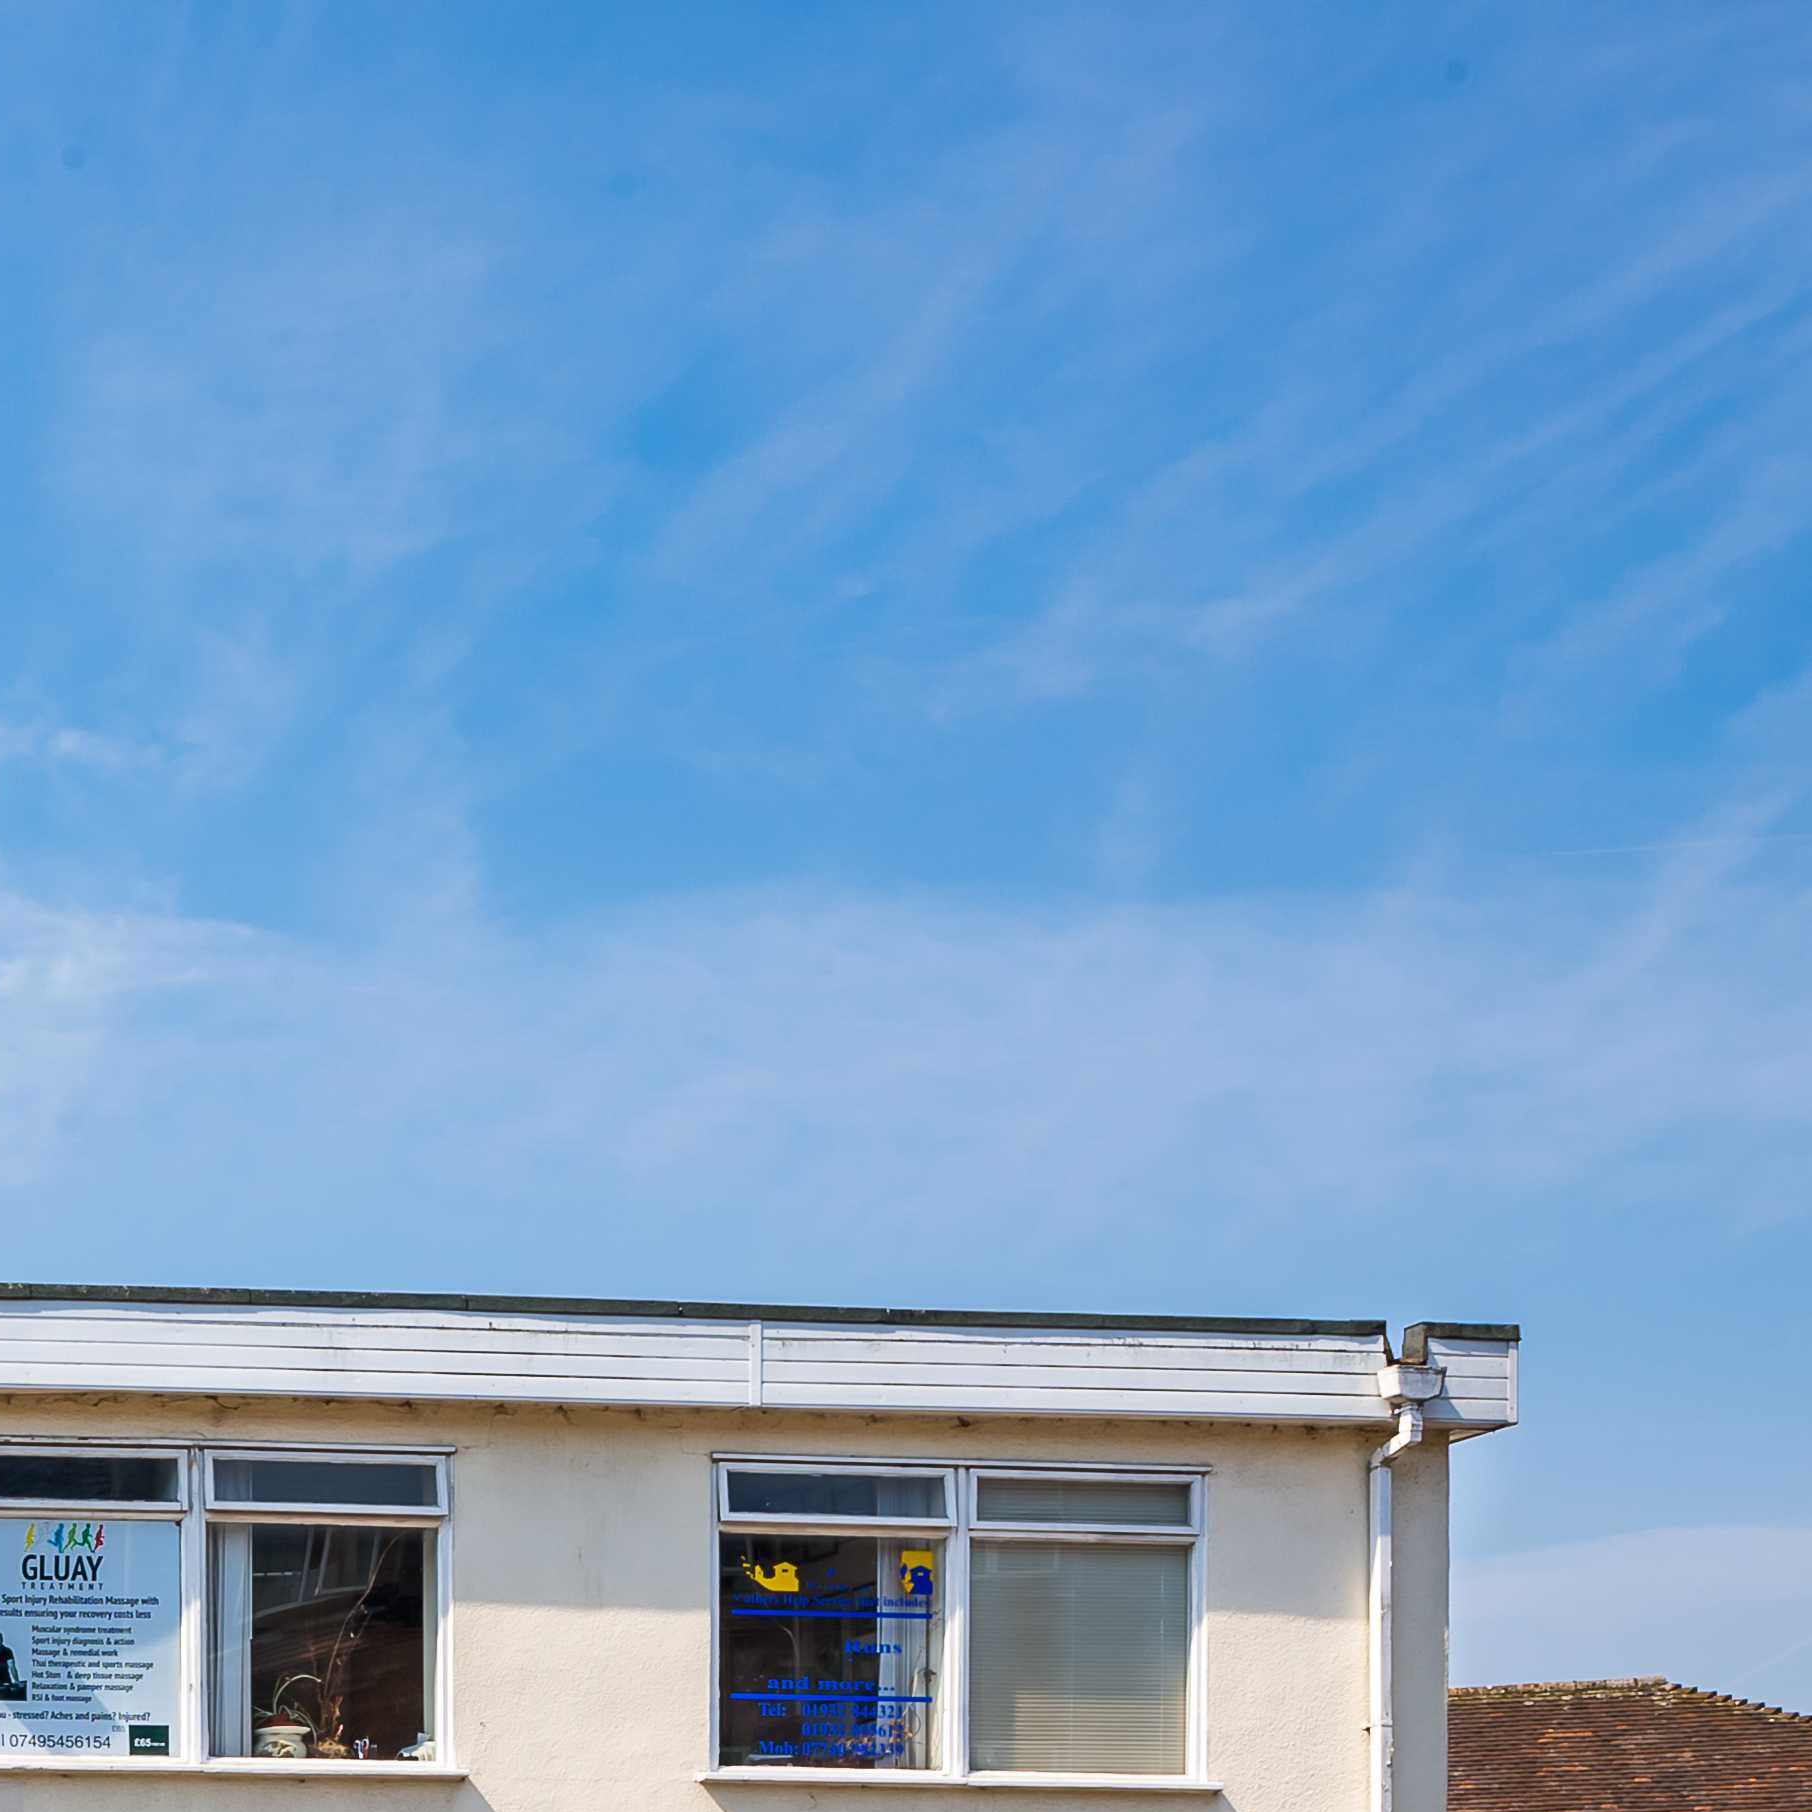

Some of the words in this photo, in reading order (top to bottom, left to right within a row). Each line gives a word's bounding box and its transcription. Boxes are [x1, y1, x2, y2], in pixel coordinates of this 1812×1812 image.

[22, 1555, 103, 1581] GLUAY
[22, 1582, 103, 1590] TREATMENT
[2, 1594, 23, 1604] Sport
[25, 1595, 46, 1605] Injury
[49, 1595, 103, 1605] Rehabilitation
[106, 1597, 139, 1606] Massage
[142, 1597, 159, 1605] with
[25, 1609, 57, 1619] ensuring
[60, 1610, 77, 1619] your
[79, 1610, 112, 1619] recovery
[114, 1610, 133, 1618] costs
[136, 1610, 151, 1618] less
[64, 1626, 96, 1634] syndrome
[32, 1636, 49, 1645] Sport
[52, 1637, 70, 1645] injury
[72, 1638, 104, 1646] diagnosis
[846, 1640, 901, 1654] Runs
[32, 1649, 59, 1657] Massage
[48, 1660, 85, 1668] therapeutic
[75, 1672, 91, 1680] deep
[768, 1676, 808, 1690] and
[760, 1703, 786, 1716] Tel:
[13, 1711, 48, 1719] stressed?
[50, 1712, 73, 1720] Aches
[91, 1713, 116, 1721] pains?
[119, 1713, 151, 1722] Injured?
[9, 1734, 110, 1748] 07495456154
[760, 1740, 798, 1755] Mob:
